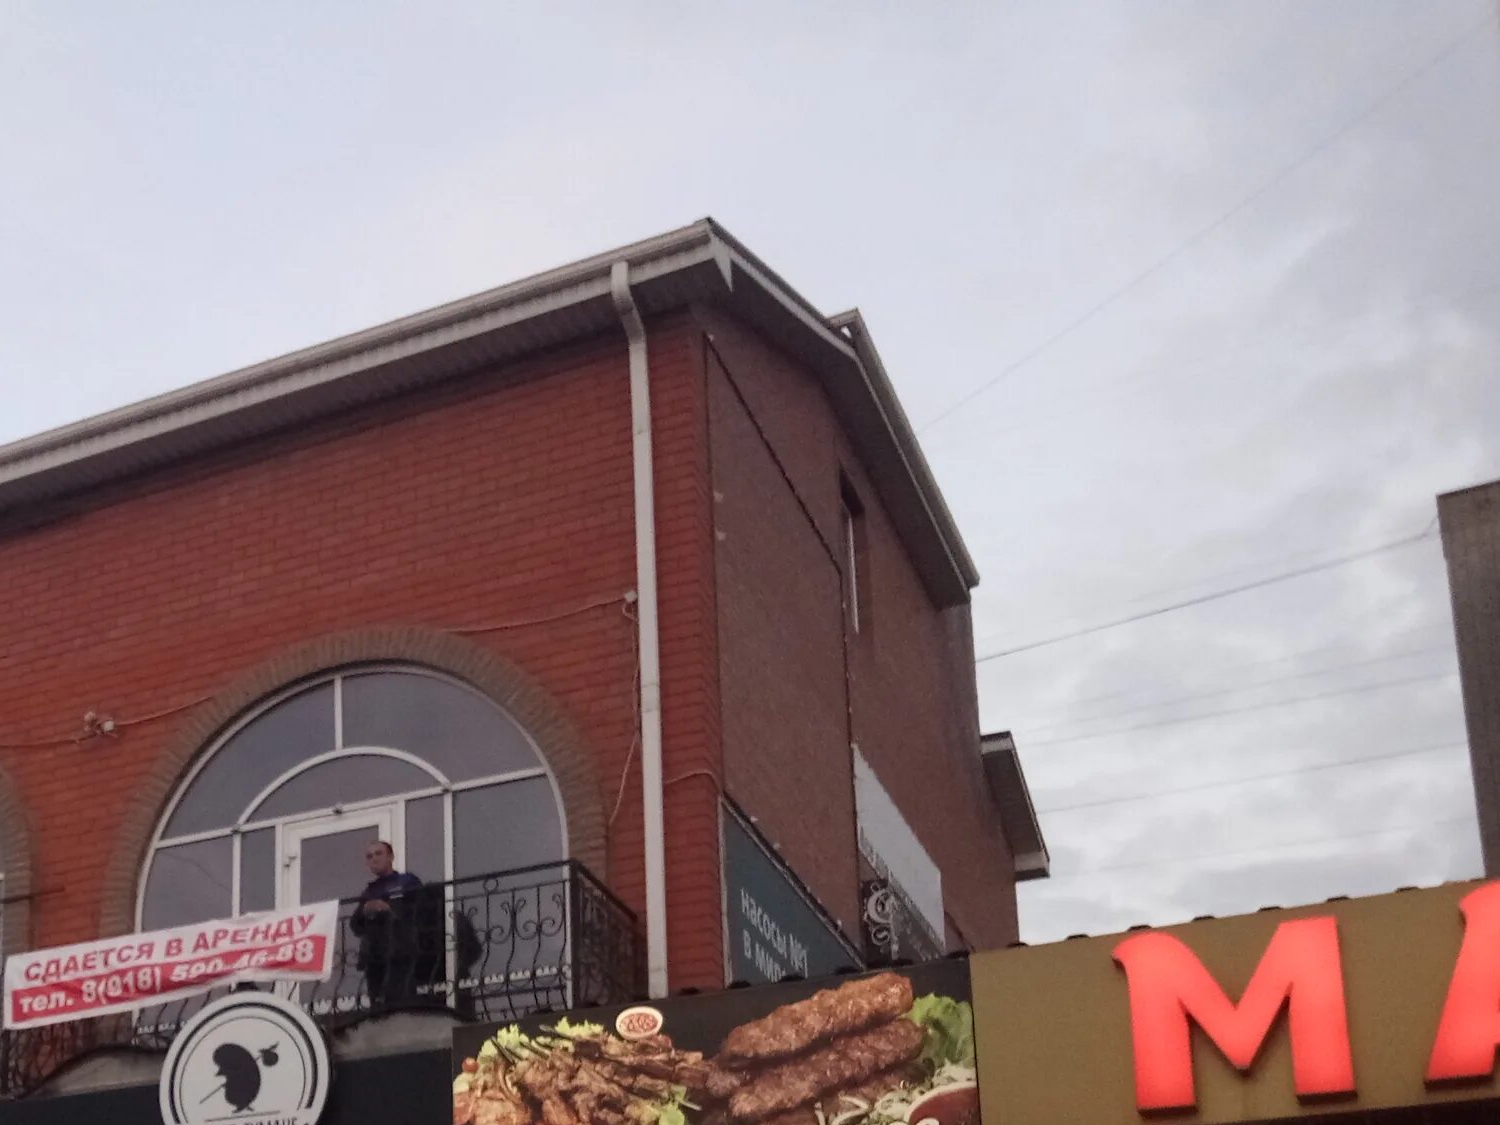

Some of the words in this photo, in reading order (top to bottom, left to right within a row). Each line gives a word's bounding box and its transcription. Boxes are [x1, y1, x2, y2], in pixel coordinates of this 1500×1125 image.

[24, 942, 154, 984] СДАЕТСЯ
[165, 938, 183, 957] В
[192, 914, 315, 953] АРЕНДУ
[20, 990, 74, 1014] тел.
